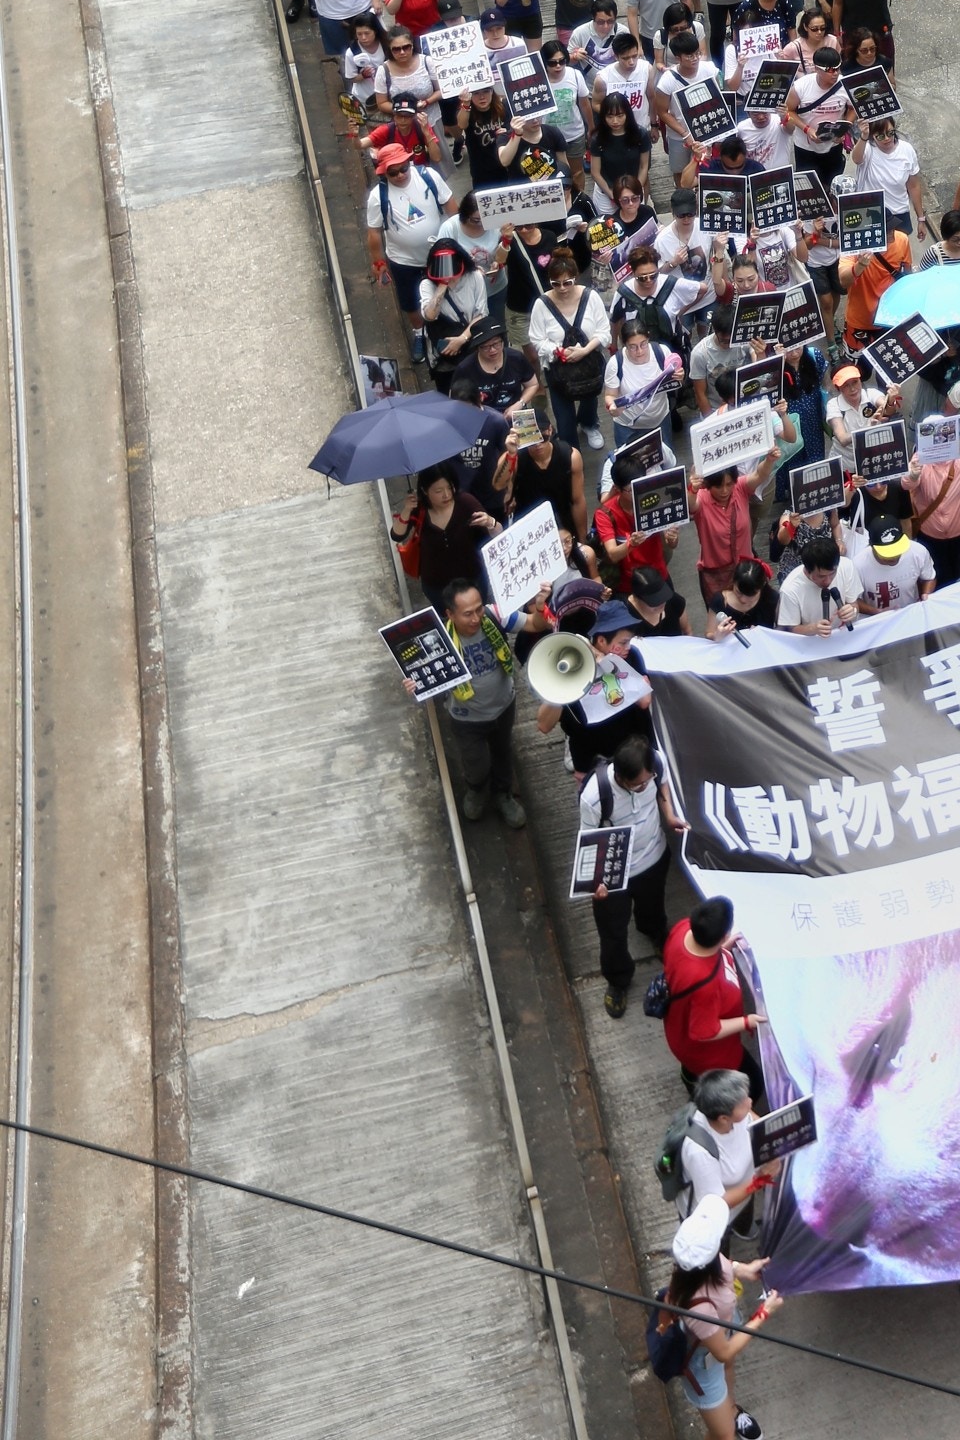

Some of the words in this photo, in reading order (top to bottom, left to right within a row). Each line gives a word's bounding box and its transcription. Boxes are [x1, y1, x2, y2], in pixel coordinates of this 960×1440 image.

[744, 25, 777, 36] EQUALITY
[512, 85, 548, 101] 虐待動物
[612, 82, 642, 90] SUPPORT
[514, 93, 551, 112] 監禁十年
[691, 108, 726, 128] 虐待動物
[694, 116, 730, 138] 監禁十年
[876, 342, 907, 379] 監禁十年
[884, 338, 915, 371] 虐待動物
[861, 450, 904, 466] 虐待動物
[861, 460, 905, 476] 監禁十年
[798, 483, 840, 501] 虐待動物
[798, 492, 841, 510] 監禁十年
